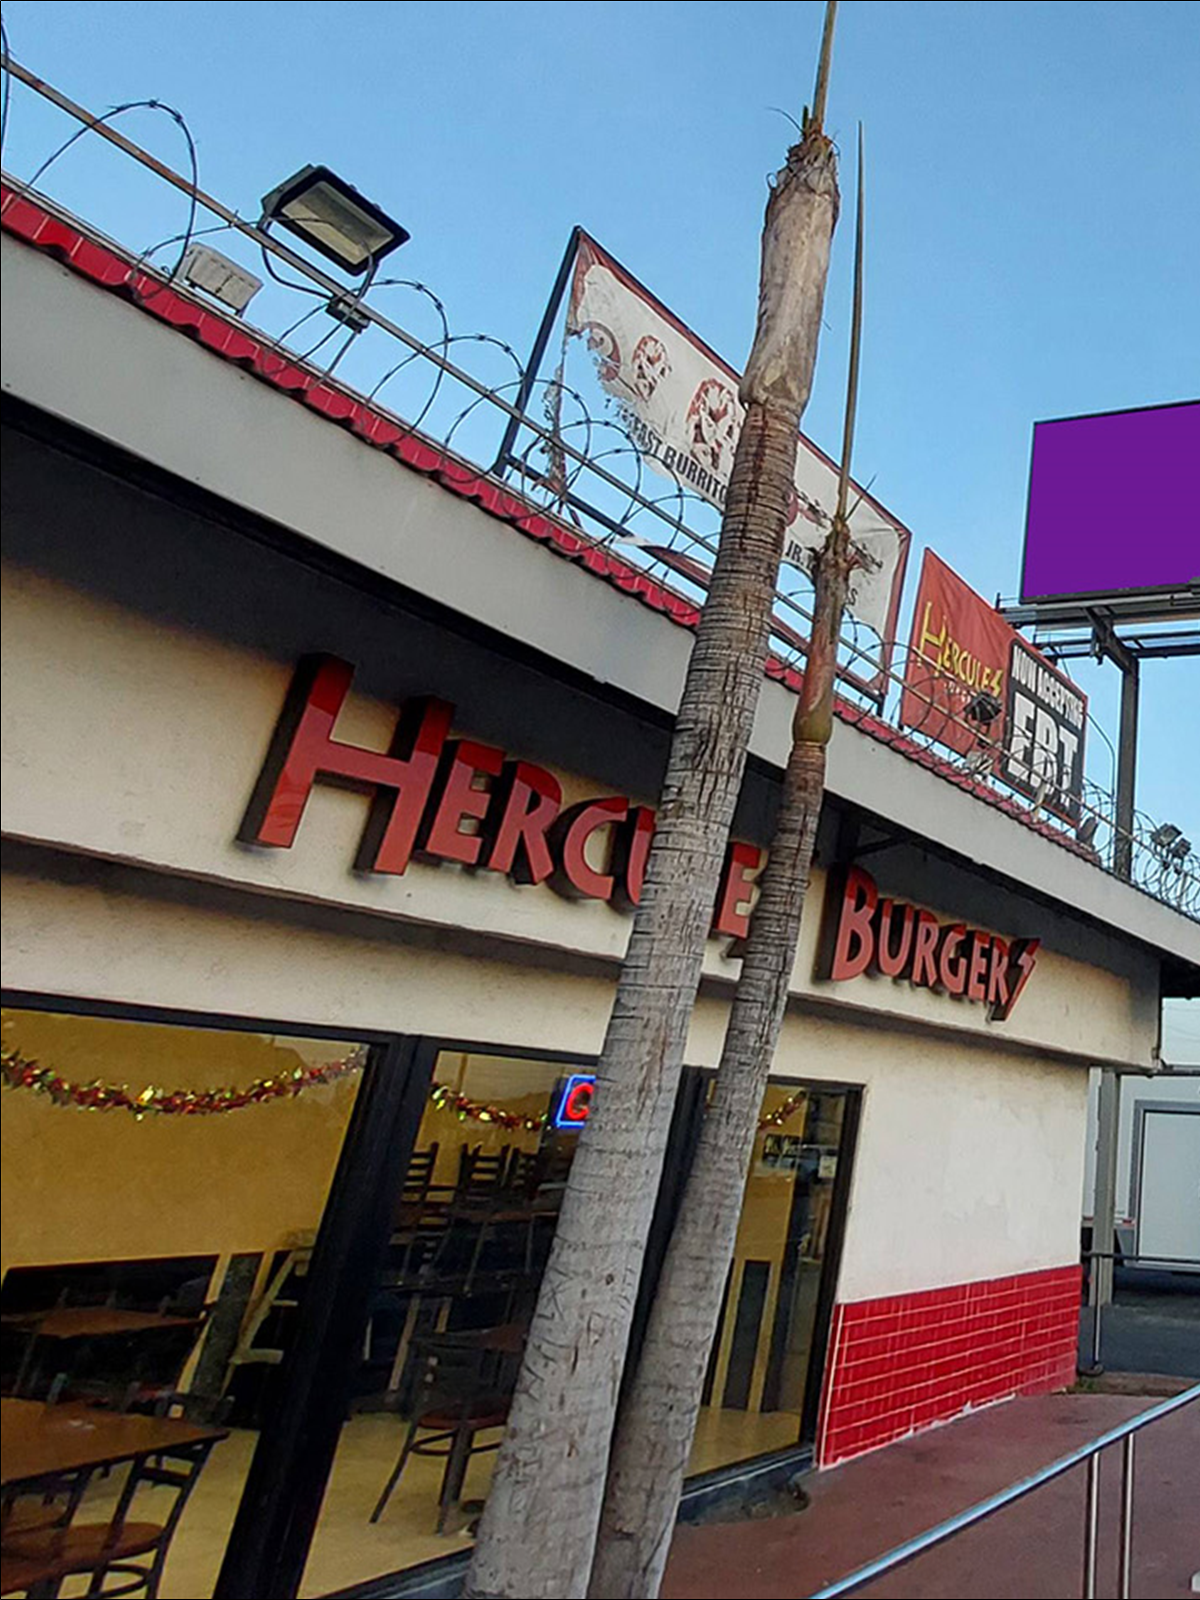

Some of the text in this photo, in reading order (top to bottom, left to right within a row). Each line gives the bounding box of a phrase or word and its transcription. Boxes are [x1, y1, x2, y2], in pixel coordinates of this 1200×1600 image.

[918, 601, 1004, 698] HERCULES
[1012, 645, 1038, 692] NOW
[1007, 691, 1079, 808] EBT
[818, 864, 1042, 1022] BURGERS
